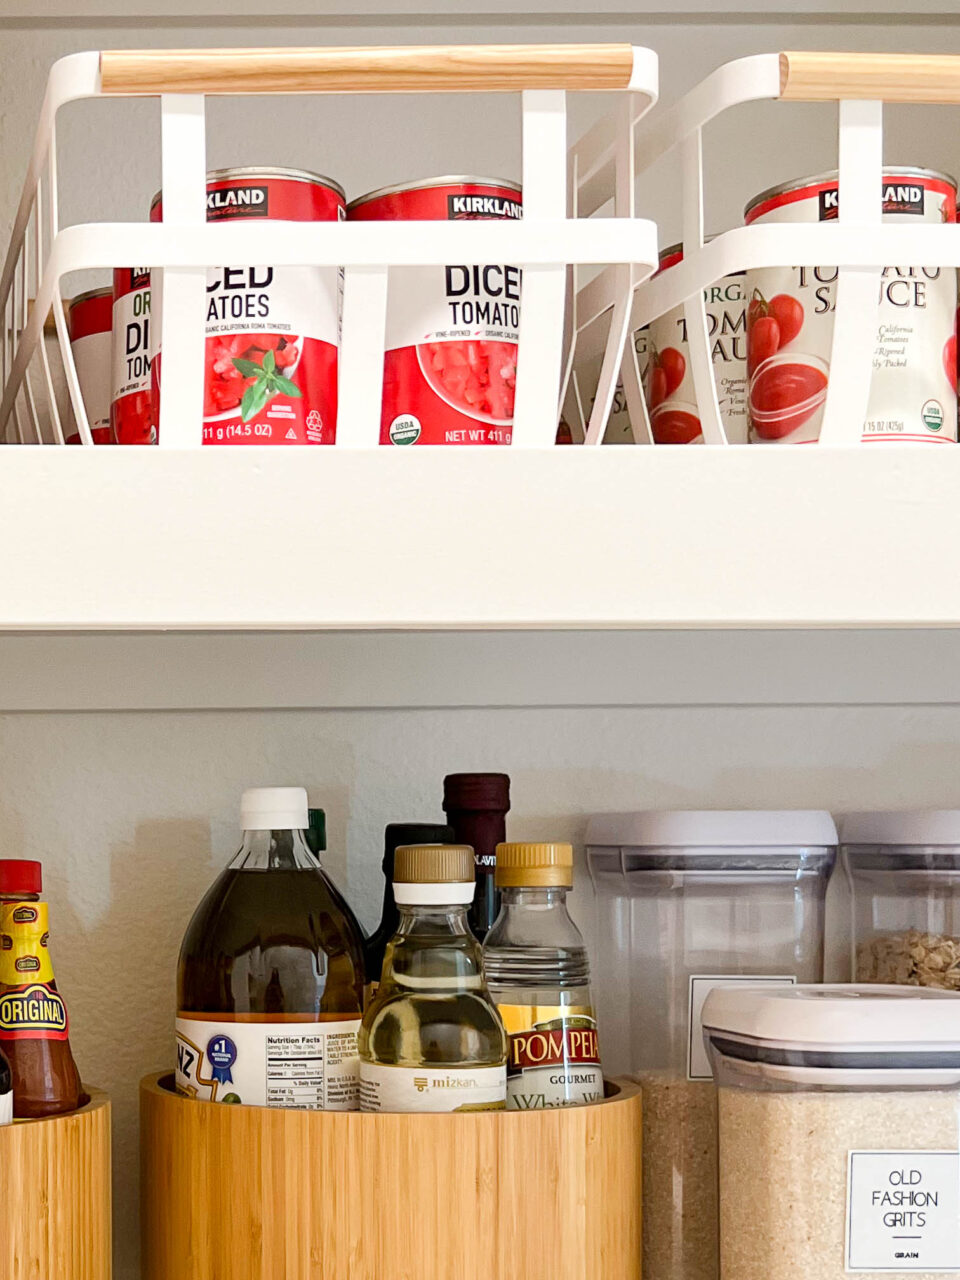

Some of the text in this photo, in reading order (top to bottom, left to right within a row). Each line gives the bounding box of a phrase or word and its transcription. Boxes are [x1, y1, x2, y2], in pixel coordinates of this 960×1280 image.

[206, 189, 265, 208] KLAND
[445, 265, 523, 301] DICE
[206, 294, 270, 322] ATOES
[449, 301, 521, 328] TOMATO
[226, 425, 251, 438] (14.5
[254, 424, 272, 437] OZ)
[395, 421, 414, 431] USDA
[445, 431, 466, 442] NET
[468, 430, 485, 441] WT
[487, 430, 503, 442] 411
[2, 1000, 64, 1023] ORIGINAL
[432, 1076, 474, 1087] mizkan
[549, 1074, 596, 1085] GOURMET
[889, 1169, 922, 1186] OLD
[872, 1190, 938, 1207] FASHION
[883, 1212, 926, 1228] GRITS
